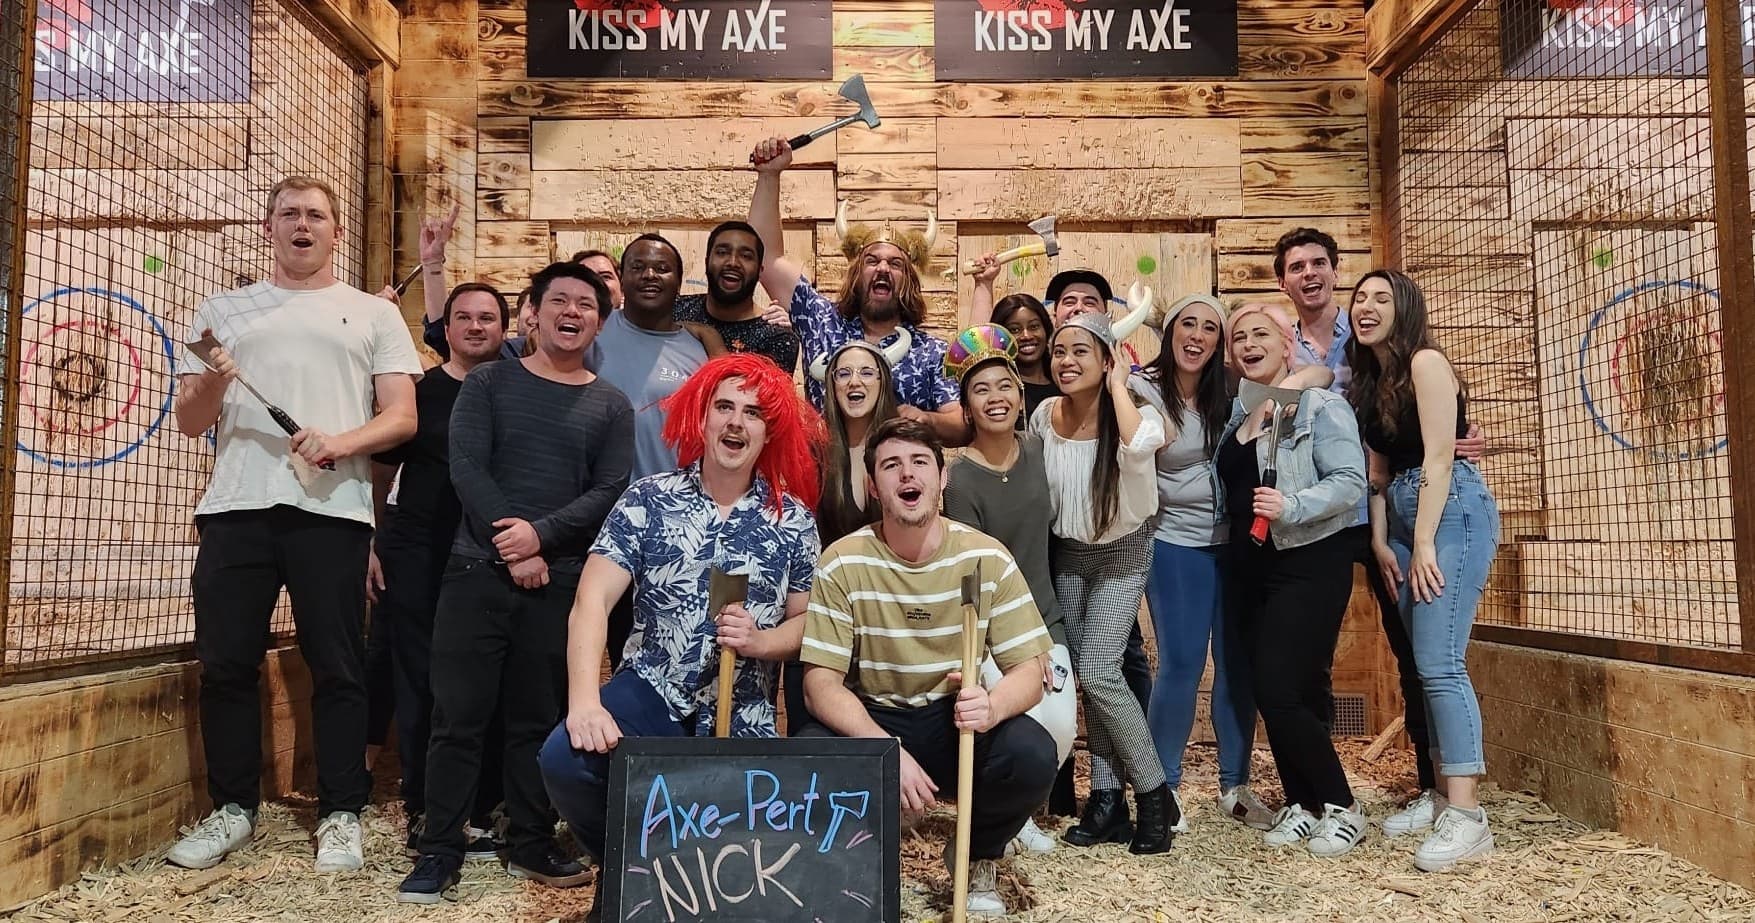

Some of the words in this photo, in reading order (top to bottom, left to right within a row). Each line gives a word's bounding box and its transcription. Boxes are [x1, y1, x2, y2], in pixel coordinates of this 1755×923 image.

[70, 30, 122, 73] MY
[134, 0, 203, 76] AXE
[568, 9, 648, 50] KISS
[660, 9, 711, 50] MY
[721, 0, 787, 52] AXE
[974, 9, 1052, 51] KISS
[1065, 9, 1115, 51] MY
[1126, 0, 1192, 52] AXE
[1541, 6, 1622, 48] KISS
[1635, 6, 1685, 48] MY
[640, 769, 820, 858] Axe-Pert
[653, 838, 804, 923] NICK
